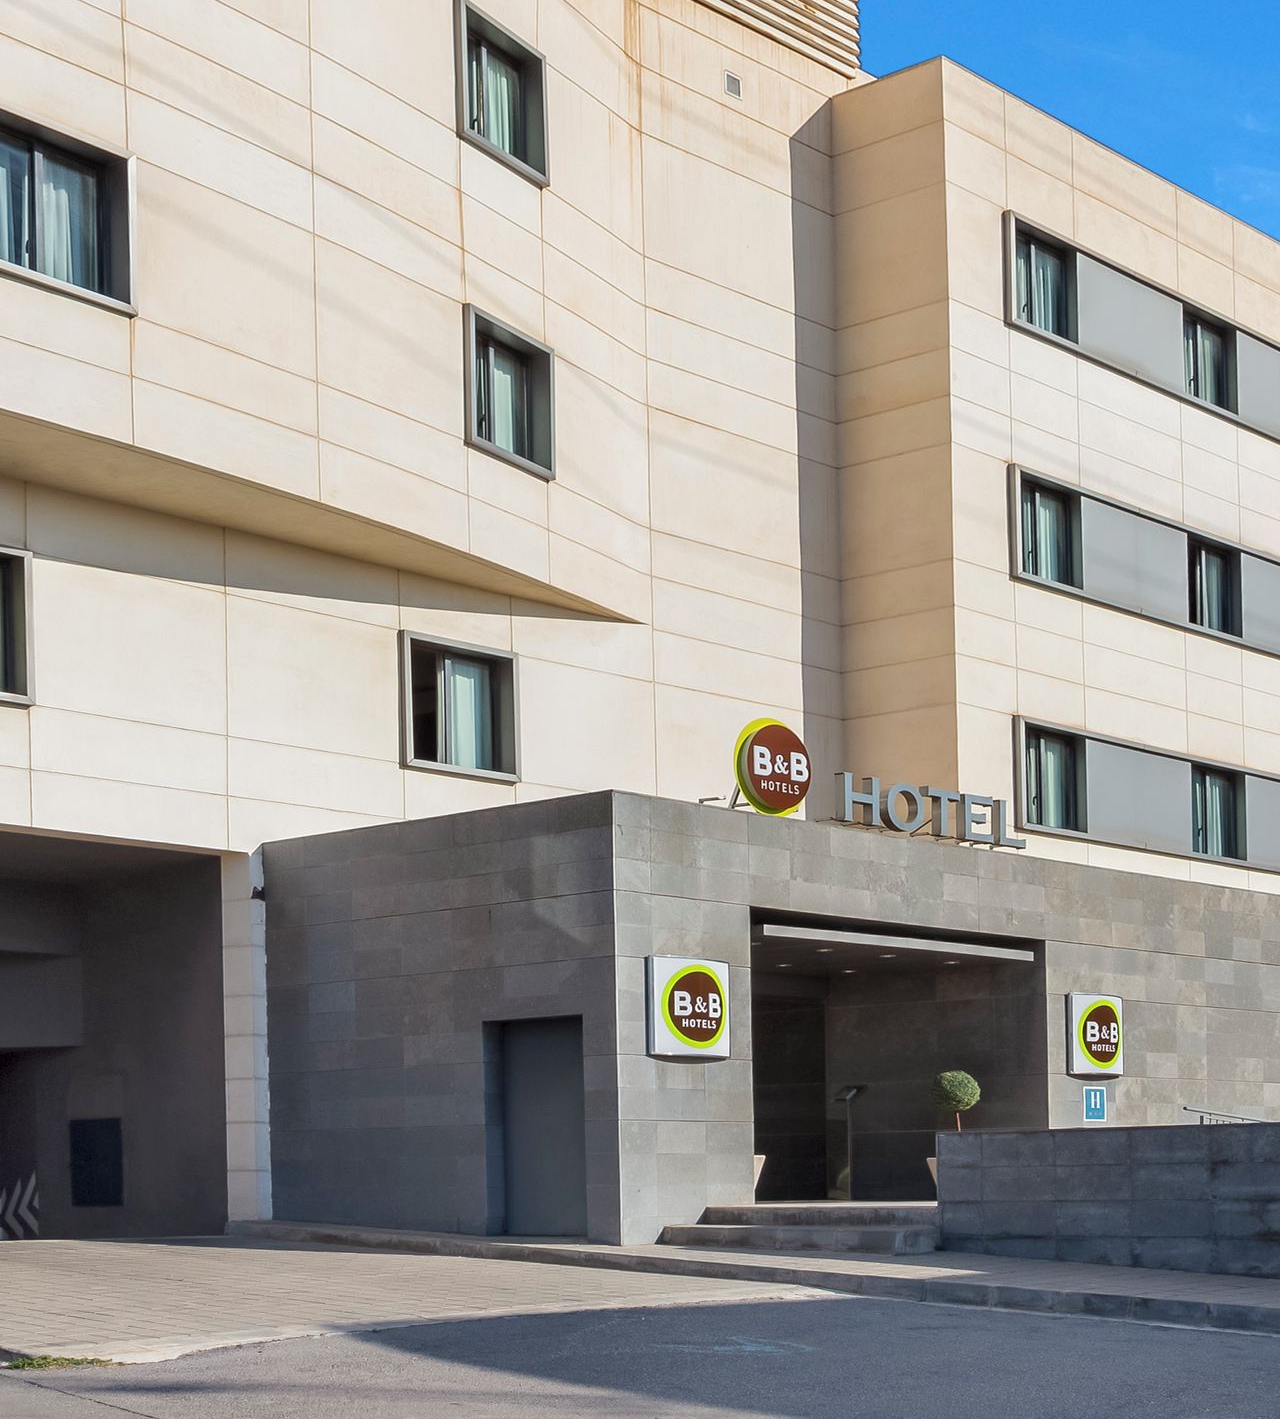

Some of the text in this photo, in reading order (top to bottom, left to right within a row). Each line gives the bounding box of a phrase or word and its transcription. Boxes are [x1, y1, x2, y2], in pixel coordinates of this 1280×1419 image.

[753, 745, 809, 783] B&B
[760, 780, 800, 795] HOTELS
[835, 772, 1026, 849] HOTEL
[674, 990, 721, 1018] B&B
[682, 1018, 717, 1029] HOTELS
[1086, 1021, 1118, 1043] B&B
[1091, 1044, 1116, 1052] HOTELS
[1090, 1091, 1101, 1109] H
